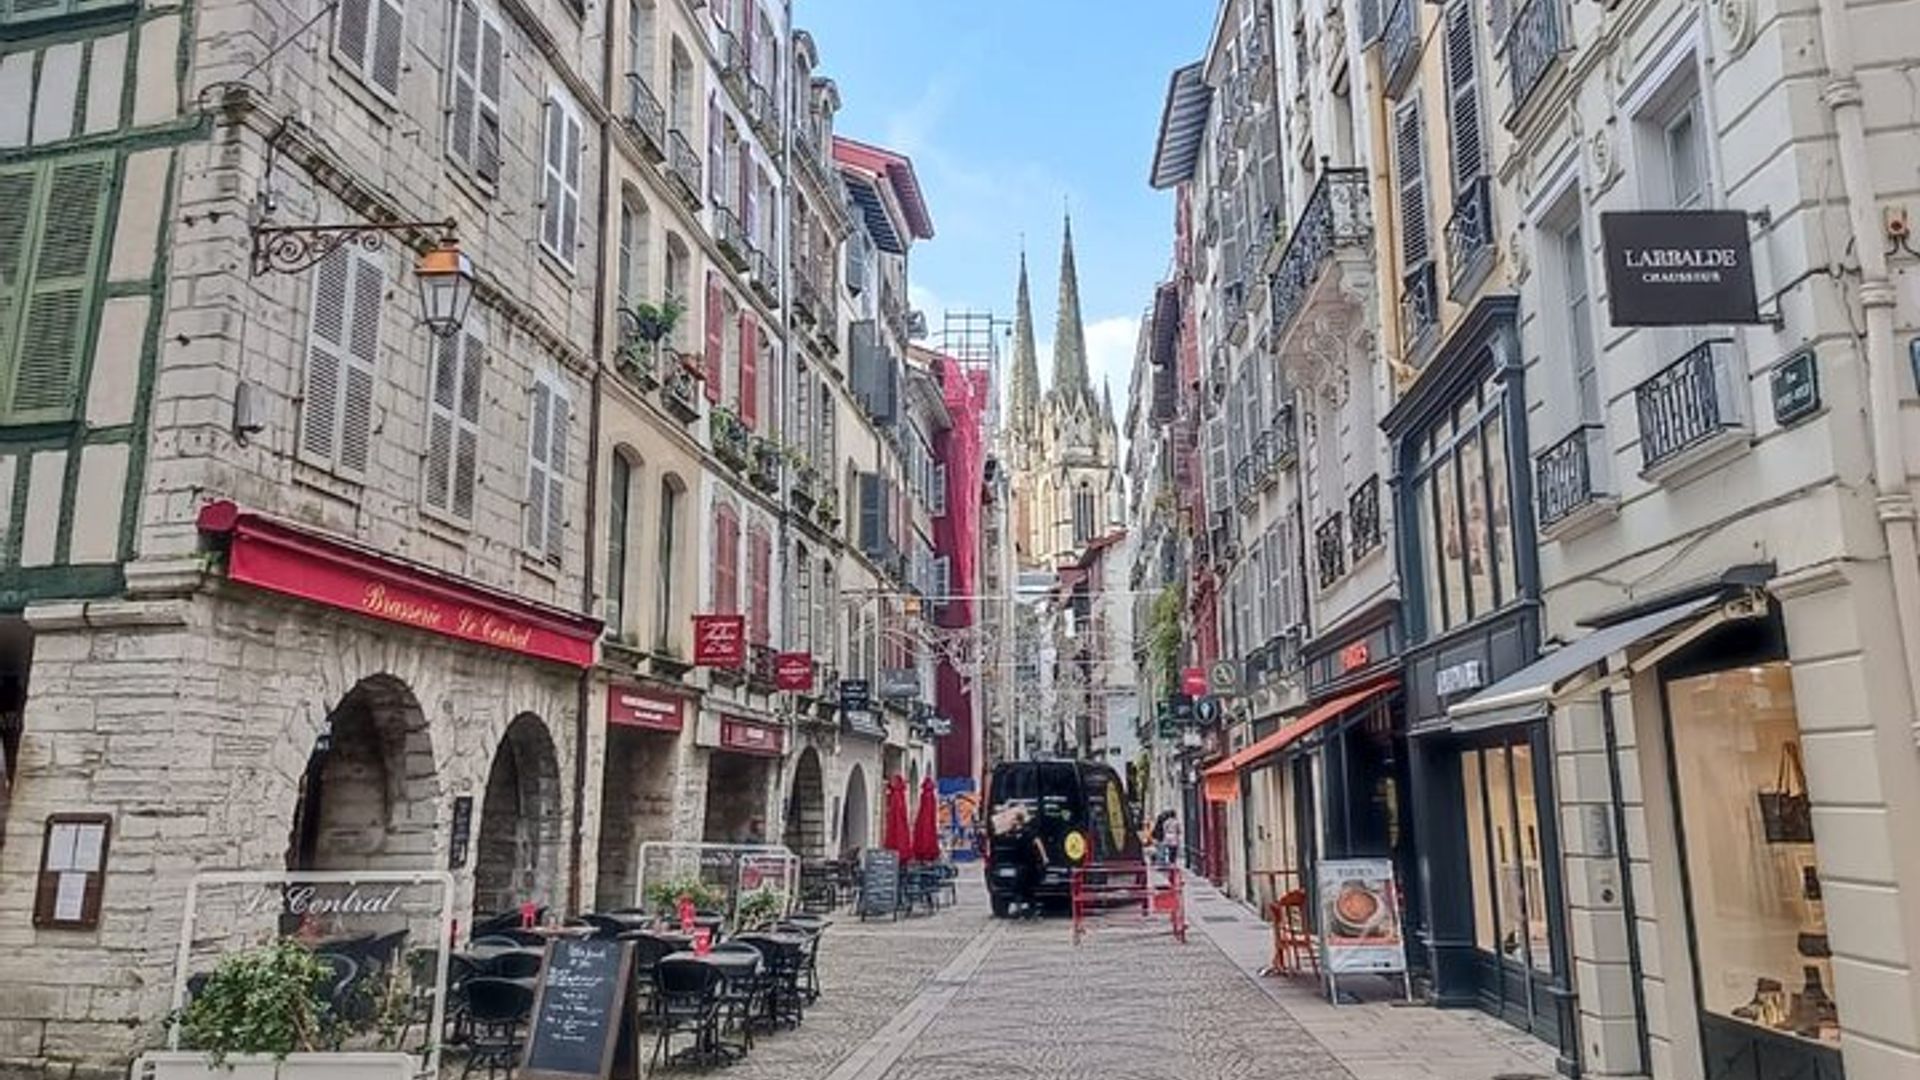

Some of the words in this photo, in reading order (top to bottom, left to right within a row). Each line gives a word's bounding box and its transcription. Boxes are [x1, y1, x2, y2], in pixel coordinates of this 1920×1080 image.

[362, 582, 443, 627] Brasserie
[457, 607, 478, 634] Le
[480, 612, 533, 648] Central
[286, 885, 401, 915] Central
